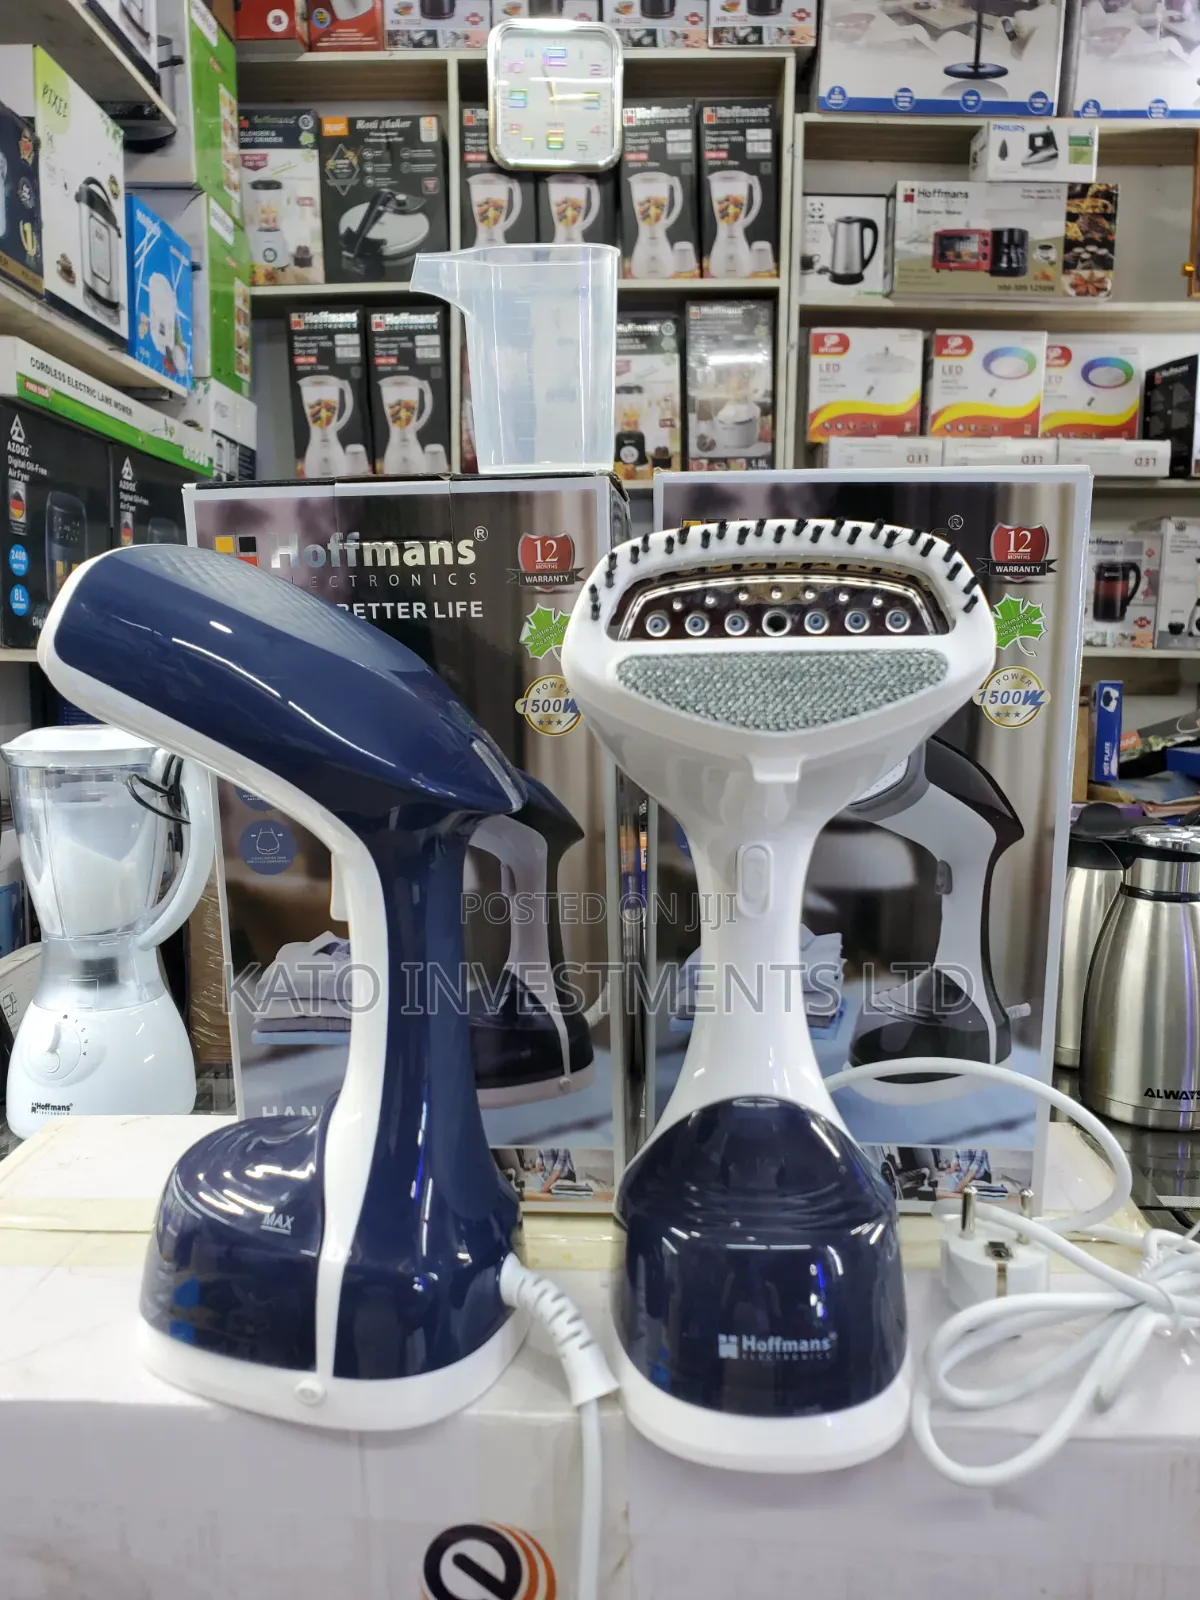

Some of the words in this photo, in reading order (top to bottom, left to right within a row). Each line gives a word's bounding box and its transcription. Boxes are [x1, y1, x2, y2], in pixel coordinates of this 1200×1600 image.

[542, 47, 567, 66] 12
[590, 63, 601, 75] 2
[508, 88, 528, 109] 9
[590, 124, 601, 137] 4
[546, 129, 564, 150] 6
[917, 188, 969, 199] Hoffmans
[304, 311, 358, 323] Hoffmans
[386, 312, 438, 324] Hoffmans
[818, 363, 841, 373] LED
[941, 364, 963, 375] LED
[30, 356, 66, 384] CORDLESS
[67, 376, 96, 398] ELECTRIC
[8, 455, 25, 469] Digital
[1007, 530, 1032, 553] 12
[1089, 537, 1123, 545] offmans
[268, 531, 477, 569] Hoffmans
[533, 540, 559, 563] 12
[995, 564, 1042, 573] WARRANTY
[292, 572, 477, 588] ECTRONICS
[525, 574, 570, 584] WARRANTY
[14, 588, 25, 601] 8L
[433, 601, 484, 618] LIFE
[997, 613, 1029, 630] hoffmans
[995, 672, 1033, 688] POWER
[535, 681, 571, 697] POWER
[520, 698, 581, 714] 1500W
[978, 690, 1046, 706] 1500W
[36, 1102, 71, 1112] Hoffmans
[262, 1105, 324, 1117] HAN
[262, 1212, 295, 1230] MAX
[742, 1334, 831, 1352] Hoffmans
